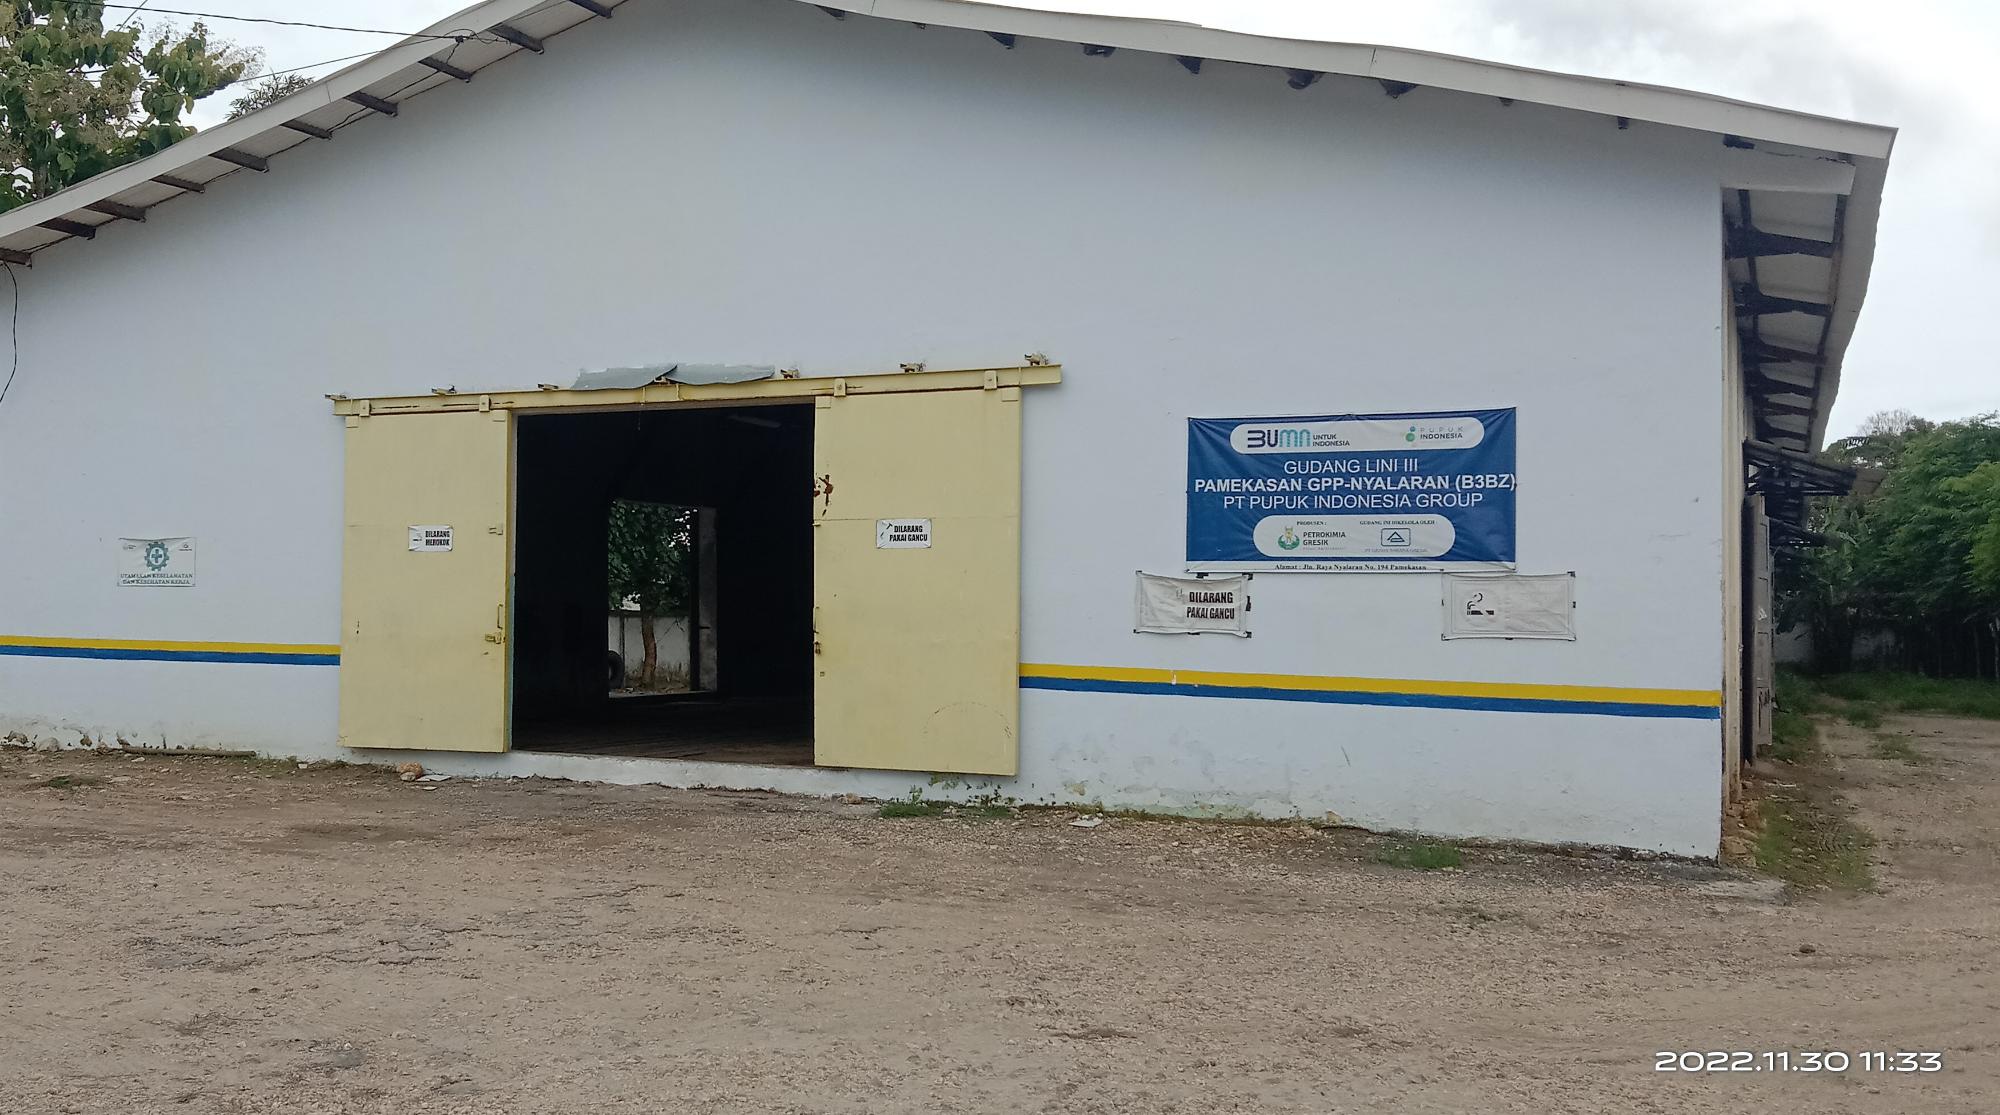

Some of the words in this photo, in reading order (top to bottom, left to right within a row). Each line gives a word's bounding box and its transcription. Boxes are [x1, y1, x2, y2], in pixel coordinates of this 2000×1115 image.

[1284, 459, 1361, 475] GUDANG
[1366, 458, 1398, 473] LINI
[1404, 458, 1418, 472] III
[1195, 478, 1302, 493] PAMEKASAN
[1308, 475, 1449, 491] GPP-NYALARAN
[1455, 473, 1516, 492] (B3BZ)
[1224, 495, 1245, 509] PT
[1250, 495, 1309, 509] PUPUK
[1314, 494, 1412, 509] INDONESIA
[1416, 492, 1483, 508] GROUP
[425, 530, 450, 538] DILARANG
[894, 525, 923, 533] DILARANG
[425, 538, 450, 546] MEROKOK
[889, 534, 907, 542] PAKAI
[908, 534, 928, 542] GANCU
[1189, 591, 1234, 604] DILARANG
[1186, 606, 1208, 619] PAKAI
[1209, 607, 1235, 619] GANCU
